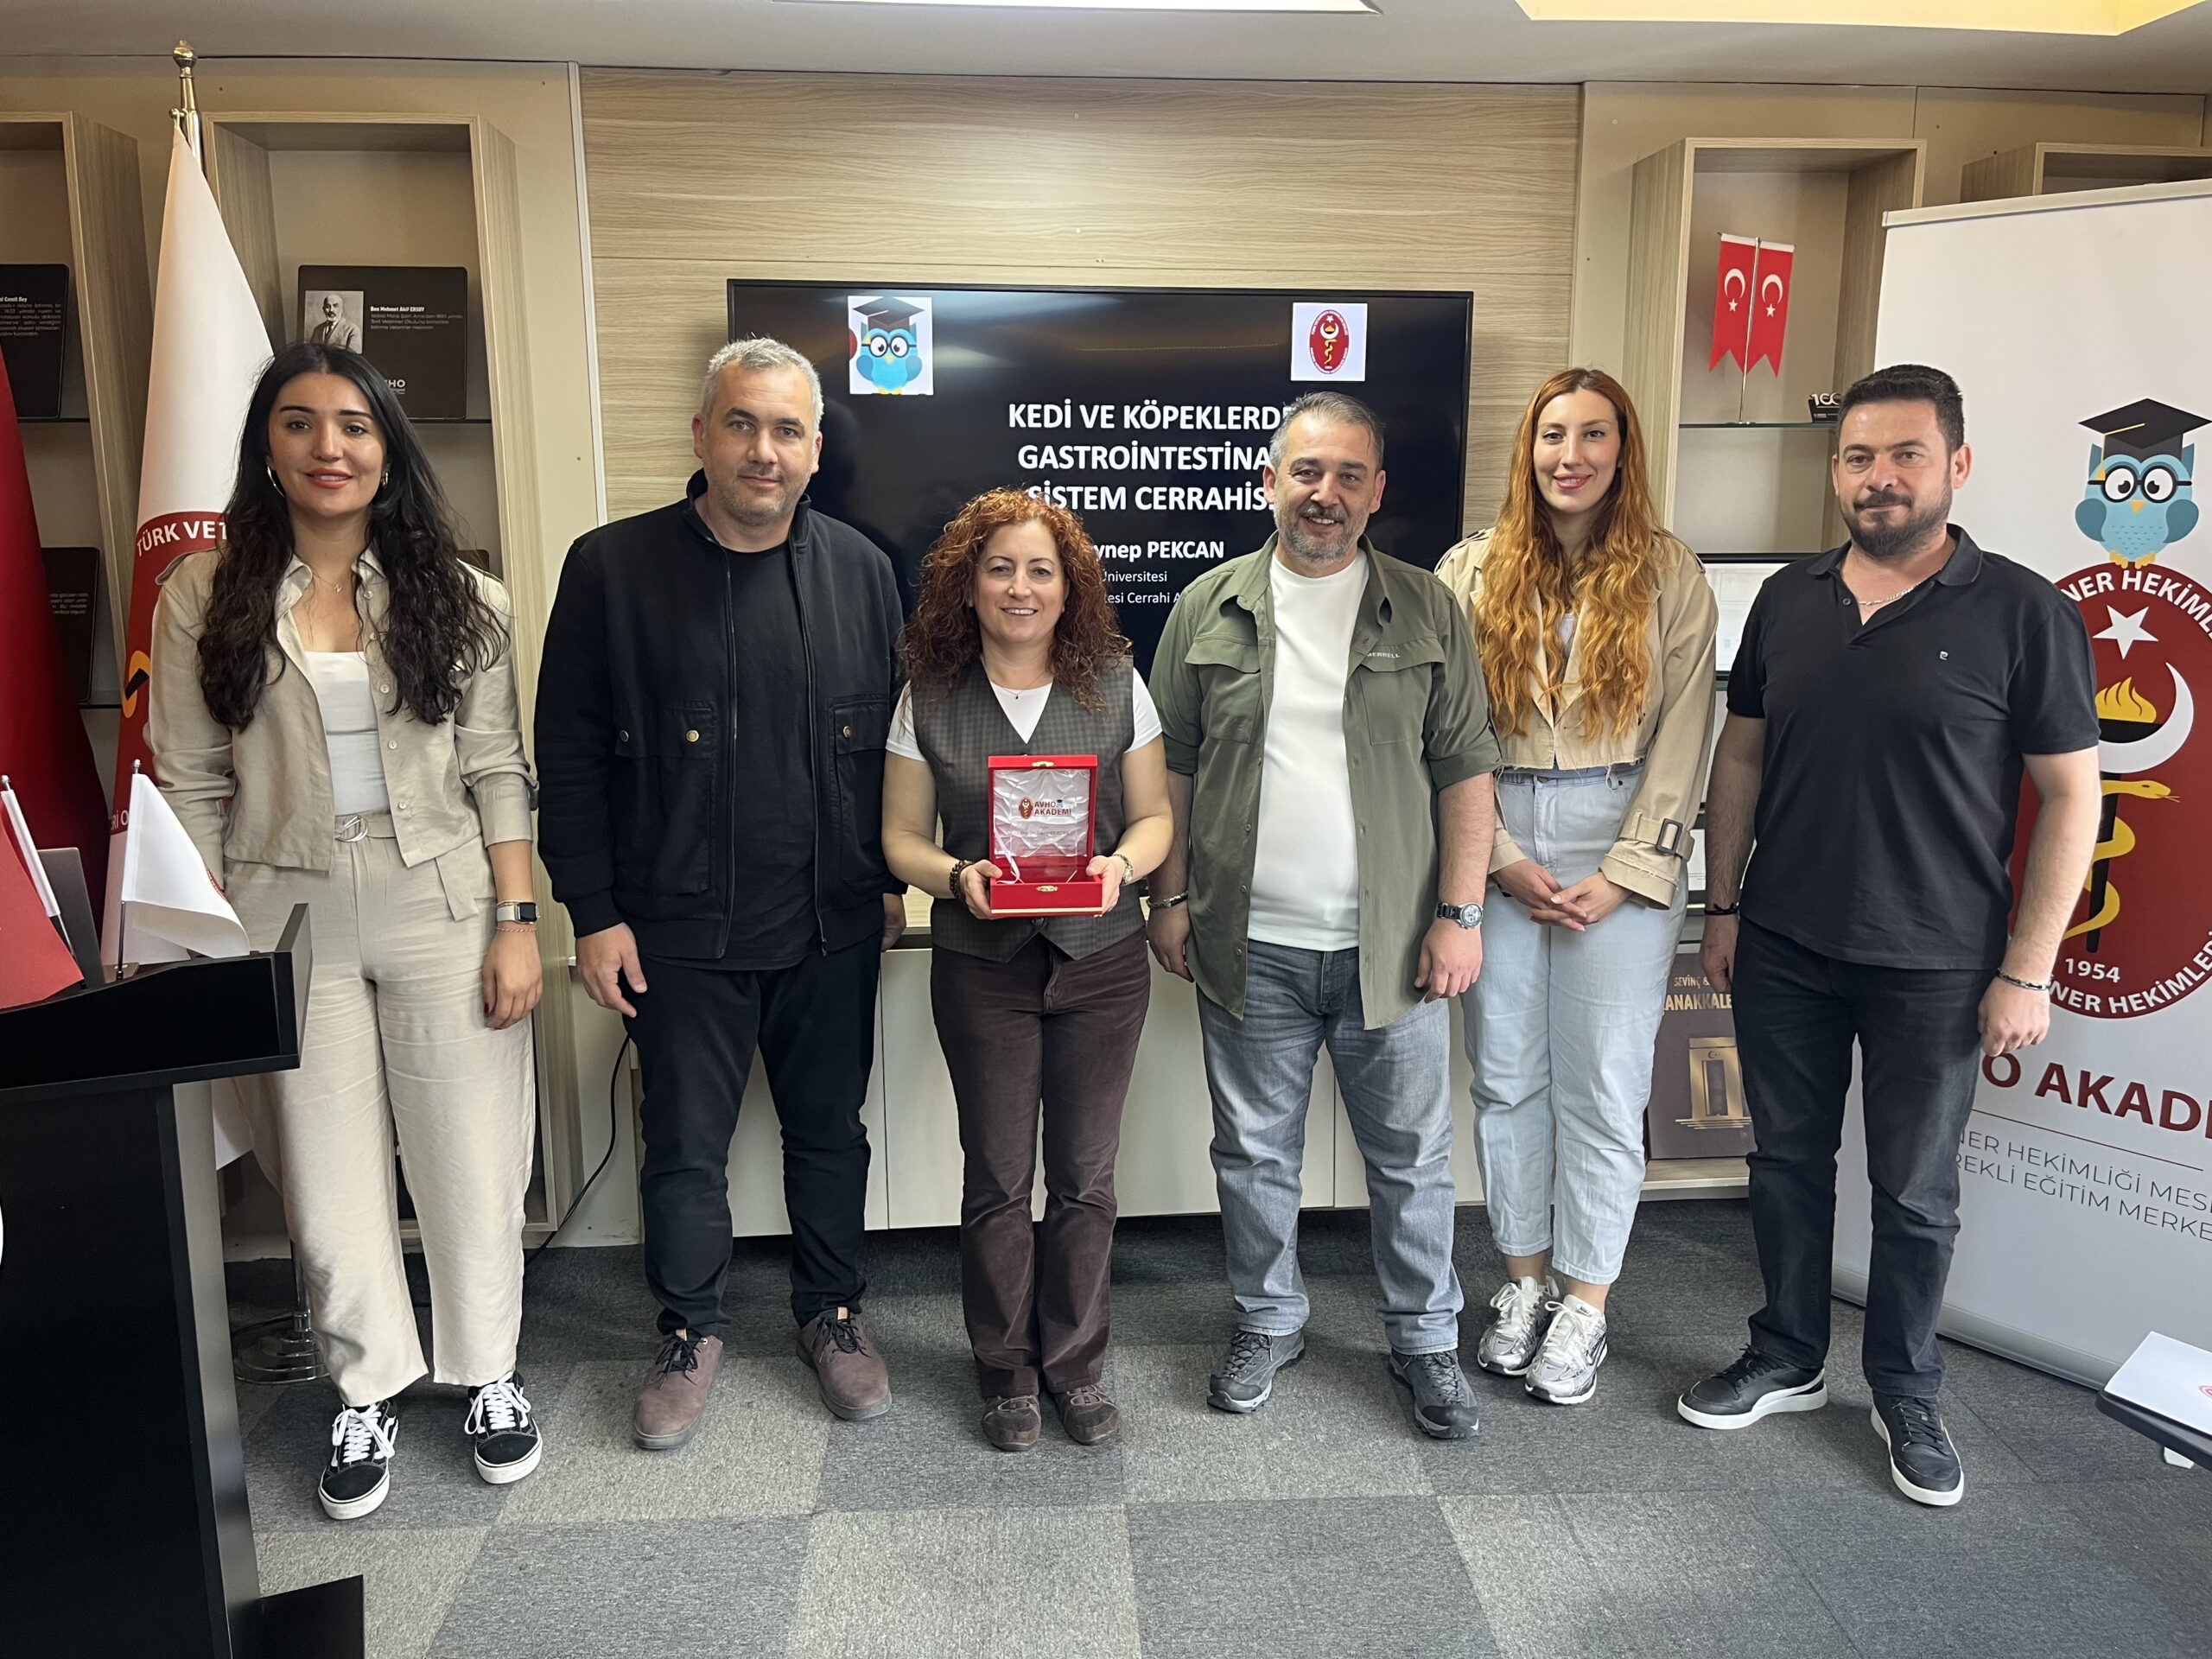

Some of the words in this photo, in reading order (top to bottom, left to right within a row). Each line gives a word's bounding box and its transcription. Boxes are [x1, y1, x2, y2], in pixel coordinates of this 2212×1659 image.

[385, 378, 406, 388] HO
[1008, 398, 1071, 429] KEDİ
[1079, 404, 1116, 429] VE
[1027, 480, 1127, 510] SİSTEM
[1135, 481, 1274, 511] CERRAHİS
[137, 523, 181, 557] TÜRK
[1147, 541, 1224, 559] PEKCAN
[1127, 592, 1170, 603] Cerrahi
[2060, 571, 2115, 602] NER
[2121, 569, 2212, 640] HEKİML
[1674, 974, 1701, 989] SEVİNÇ
[1702, 976, 1711, 986] &
[2065, 958, 2120, 983] 1954
[1662, 993, 1732, 1016] ANAKKALE
[1981, 1052, 2022, 1088] O
[2007, 1141, 2141, 1193] HEKİMLİĞİ
[2150, 1180, 2212, 1214] MES
[2024, 1173, 2109, 1212] EĞİTİM
